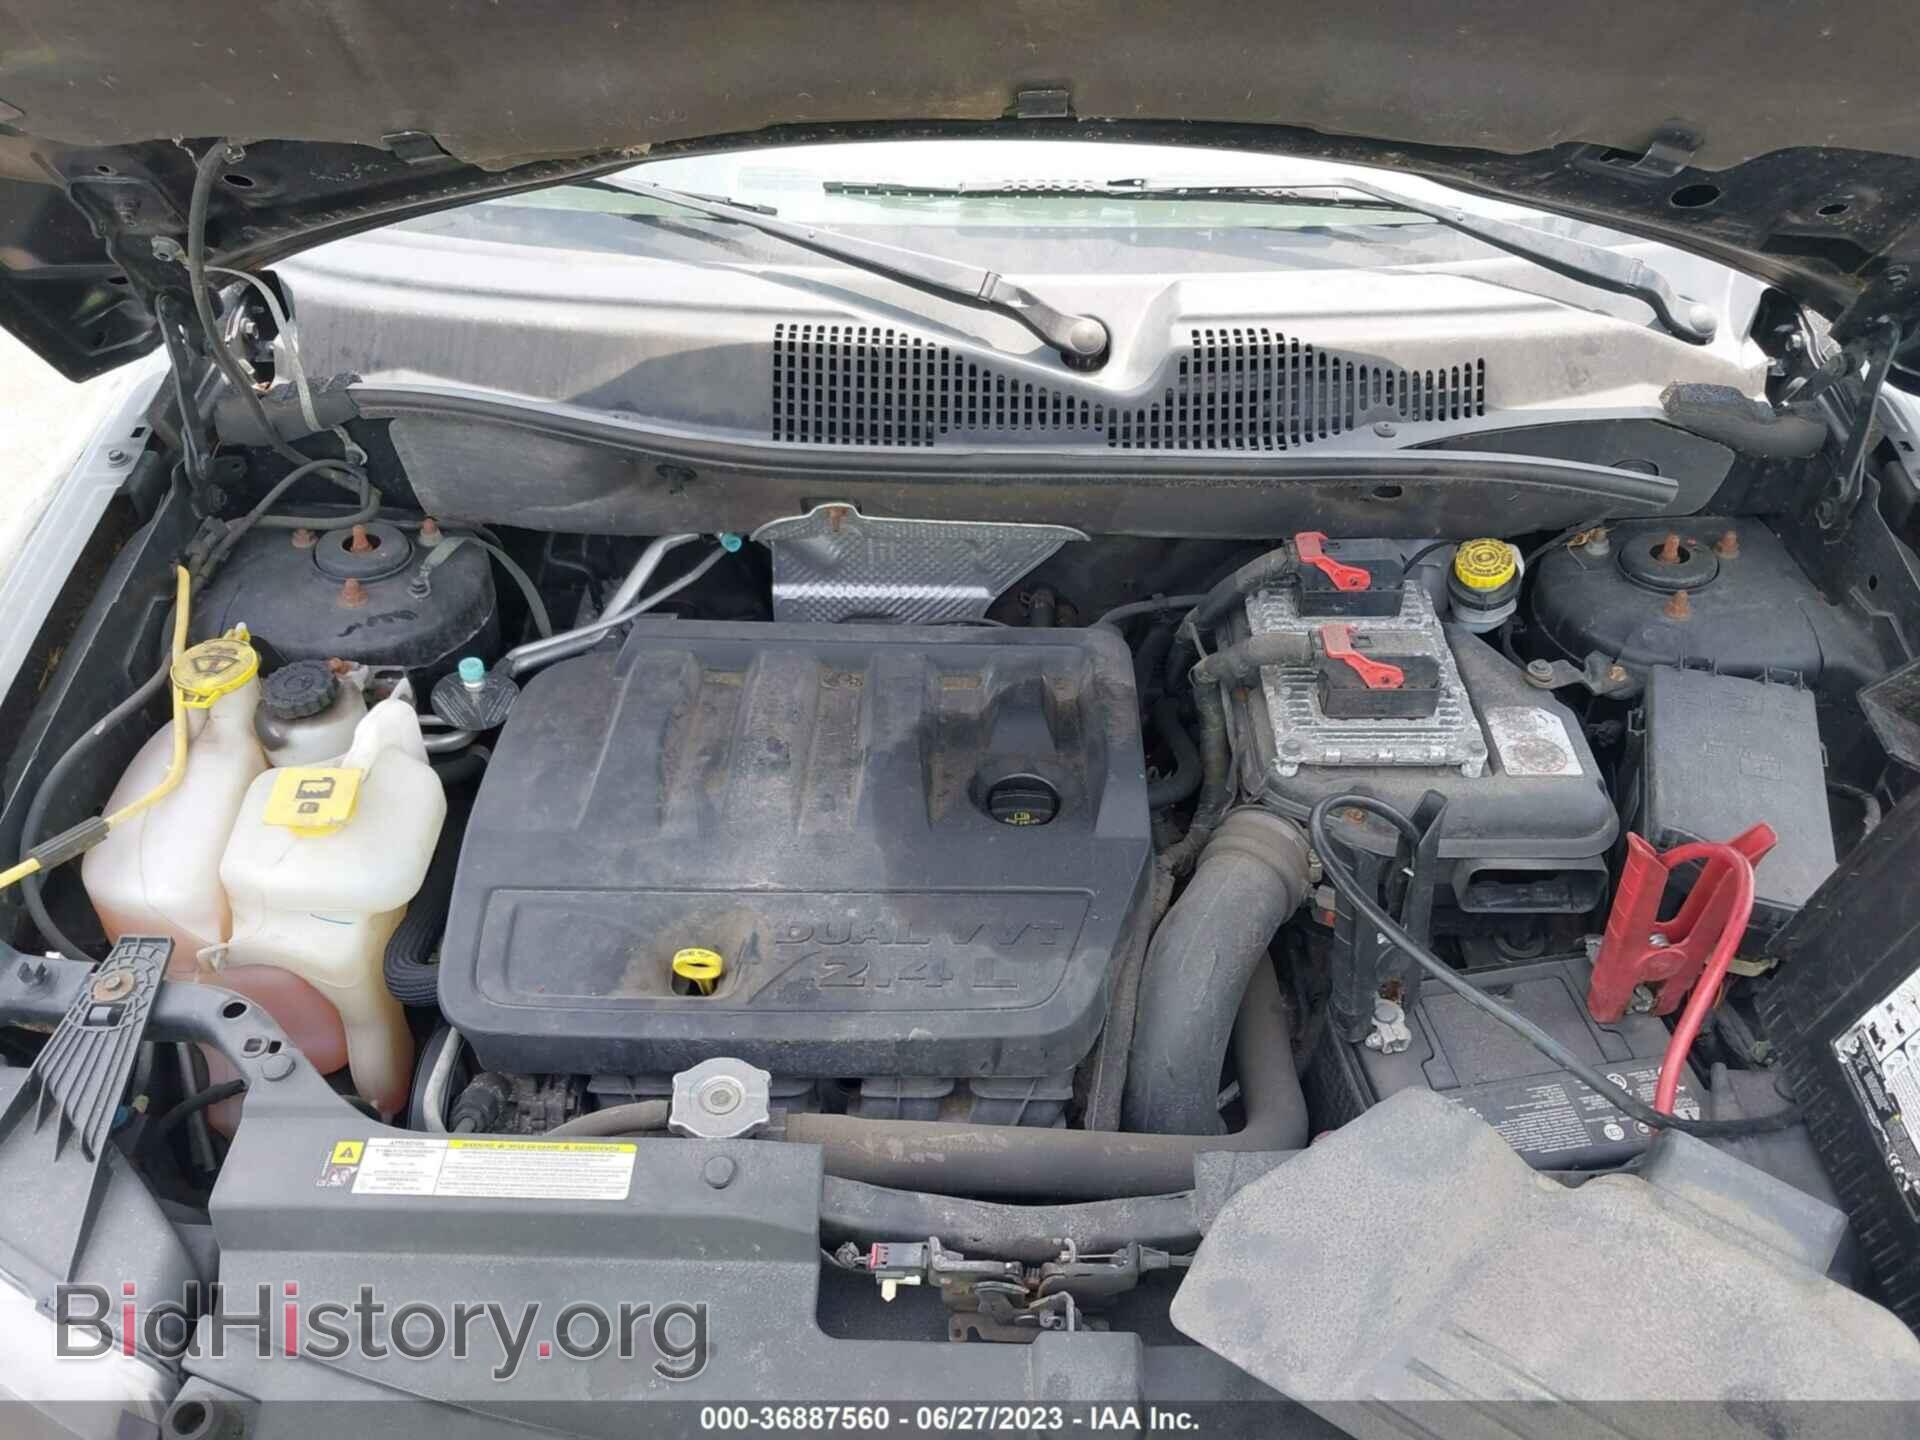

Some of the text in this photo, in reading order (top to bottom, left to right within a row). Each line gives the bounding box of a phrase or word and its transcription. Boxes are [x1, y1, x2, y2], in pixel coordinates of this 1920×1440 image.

[775, 921, 1065, 946] DUAL VVT
[818, 955, 1019, 988] 2.4L
